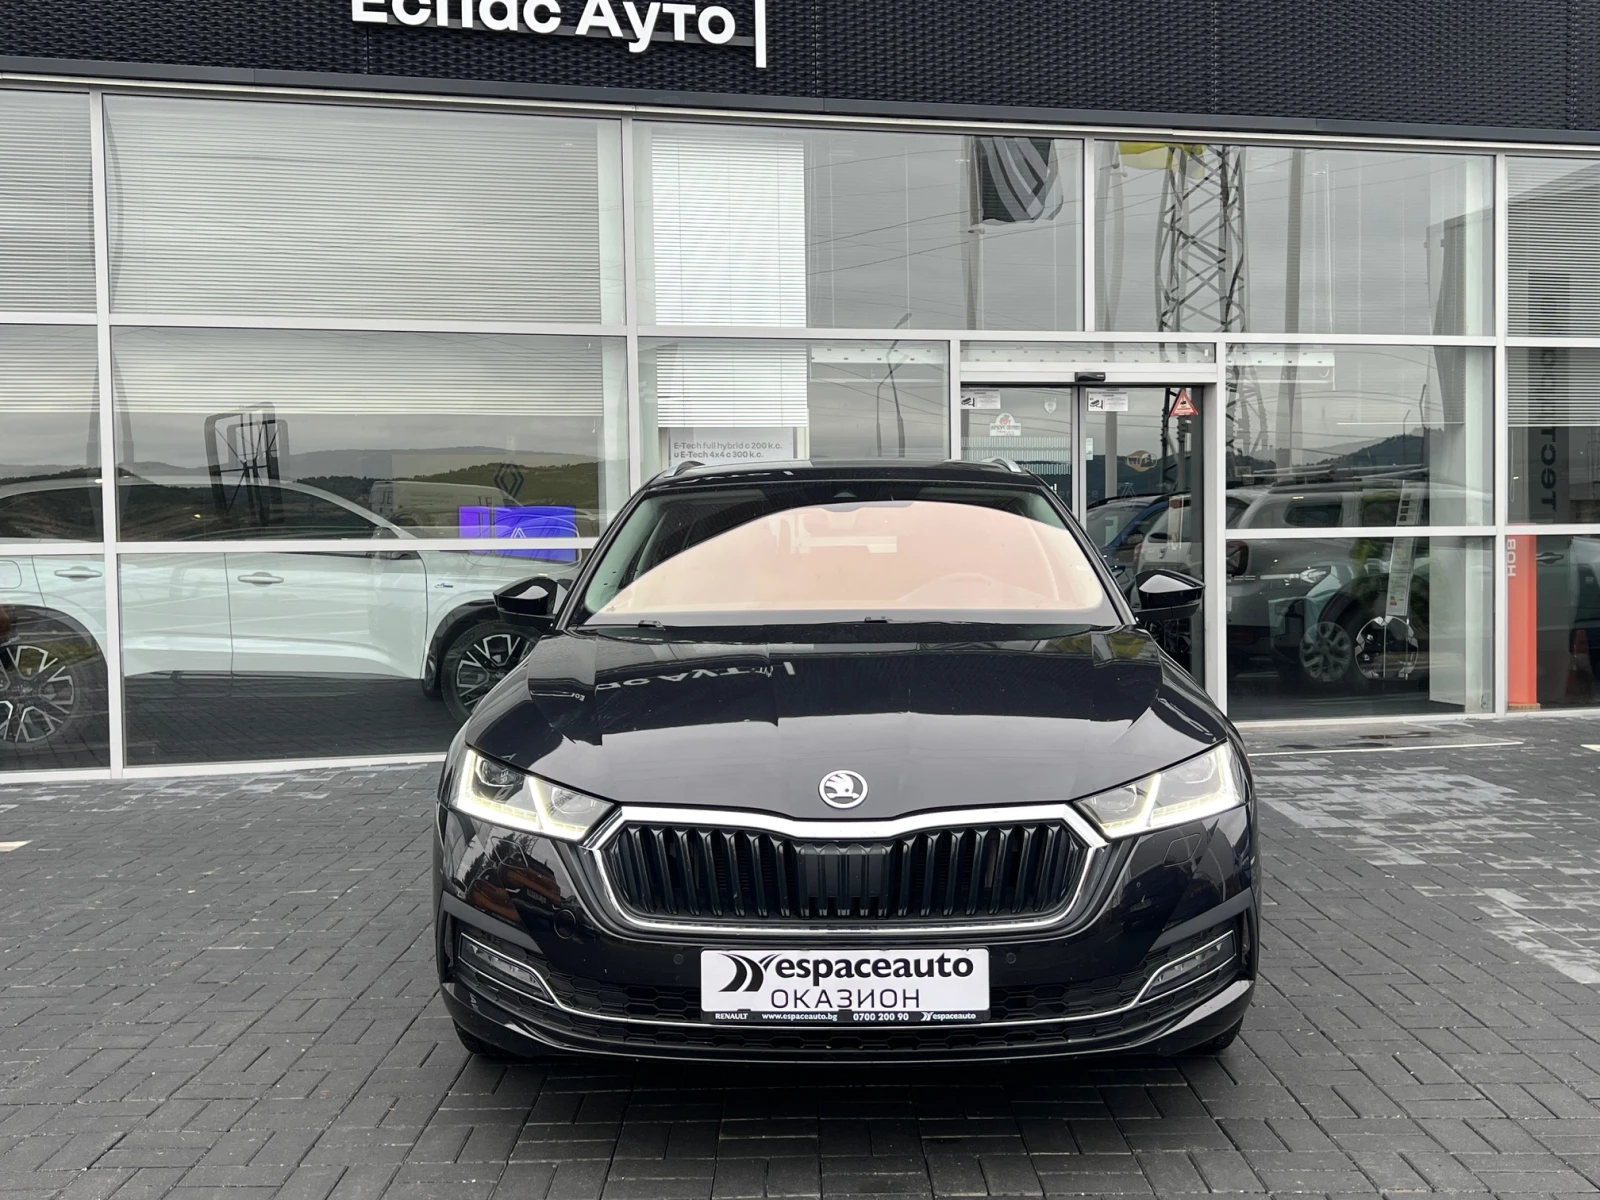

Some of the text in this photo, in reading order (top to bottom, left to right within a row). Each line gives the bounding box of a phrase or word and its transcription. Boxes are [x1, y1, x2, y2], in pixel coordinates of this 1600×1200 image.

[574, 0, 736, 53] Ауто
[673, 442, 701, 450] E-Tech
[702, 442, 716, 450] full
[717, 442, 744, 451] hybrid
[751, 442, 767, 450] 200
[680, 450, 708, 458] E-Tech
[709, 450, 725, 458] 4x4
[732, 450, 748, 458] 300
[774, 952, 974, 987] espaceauto
[770, 988, 920, 1009] ОКАЗИОН
[715, 1012, 977, 1022] RENAULT www.espaceauto.bg 0700 200 90 espaceauto
